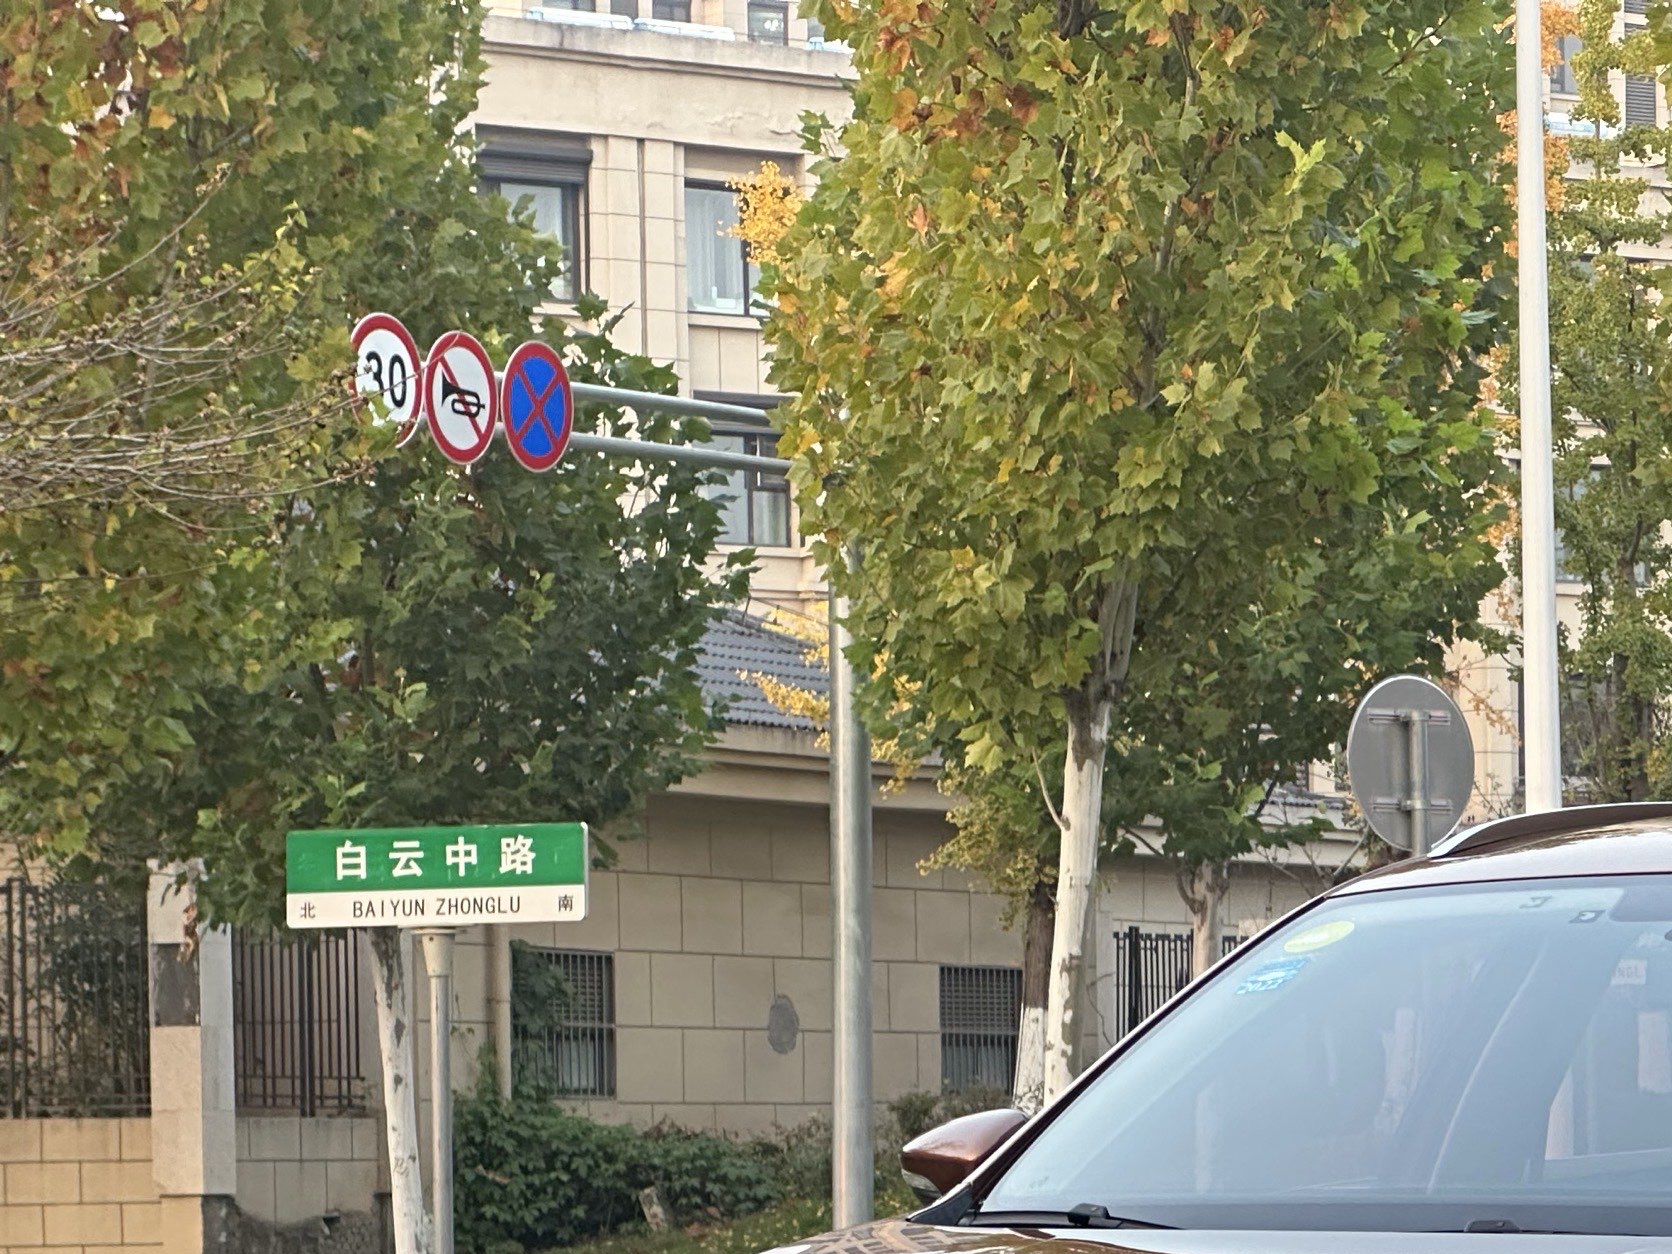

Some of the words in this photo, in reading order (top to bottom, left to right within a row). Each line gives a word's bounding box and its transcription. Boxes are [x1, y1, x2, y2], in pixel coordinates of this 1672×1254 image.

[365, 350, 407, 408] 30
[335, 834, 536, 881] 白云中路
[299, 902, 317, 919] 北
[352, 897, 426, 919] BAIYUN
[435, 895, 522, 916] ZHONGLU
[558, 893, 574, 913] 南
